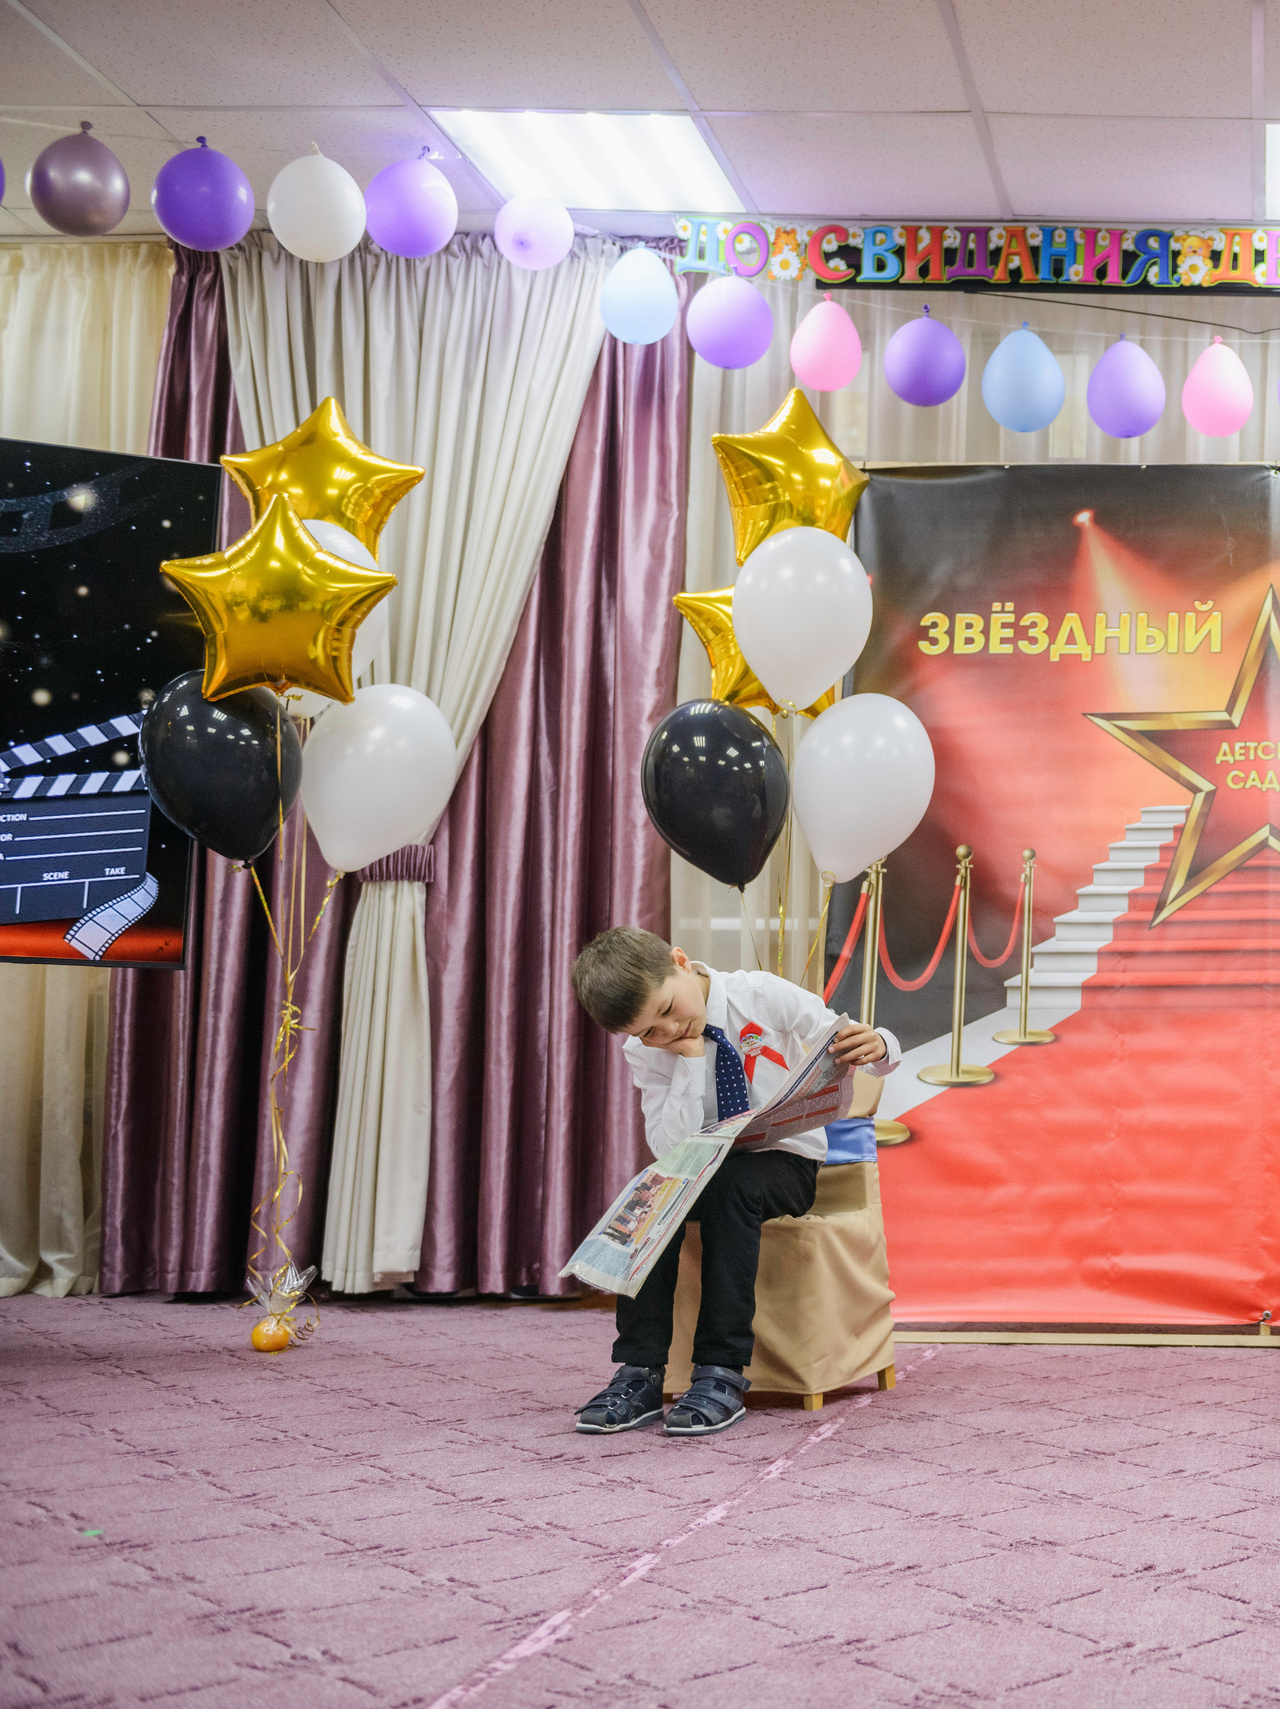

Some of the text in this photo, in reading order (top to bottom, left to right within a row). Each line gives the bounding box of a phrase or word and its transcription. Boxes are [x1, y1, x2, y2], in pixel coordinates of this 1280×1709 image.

[675, 216, 770, 278] ДО
[807, 224, 1182, 286] СВИДАНИЯ
[917, 600, 1223, 662] ЗВЁЗДНЫЙ
[1226, 769, 1280, 792] САД
[42, 871, 70, 881] SCENE
[104, 866, 126, 876] TAKE
